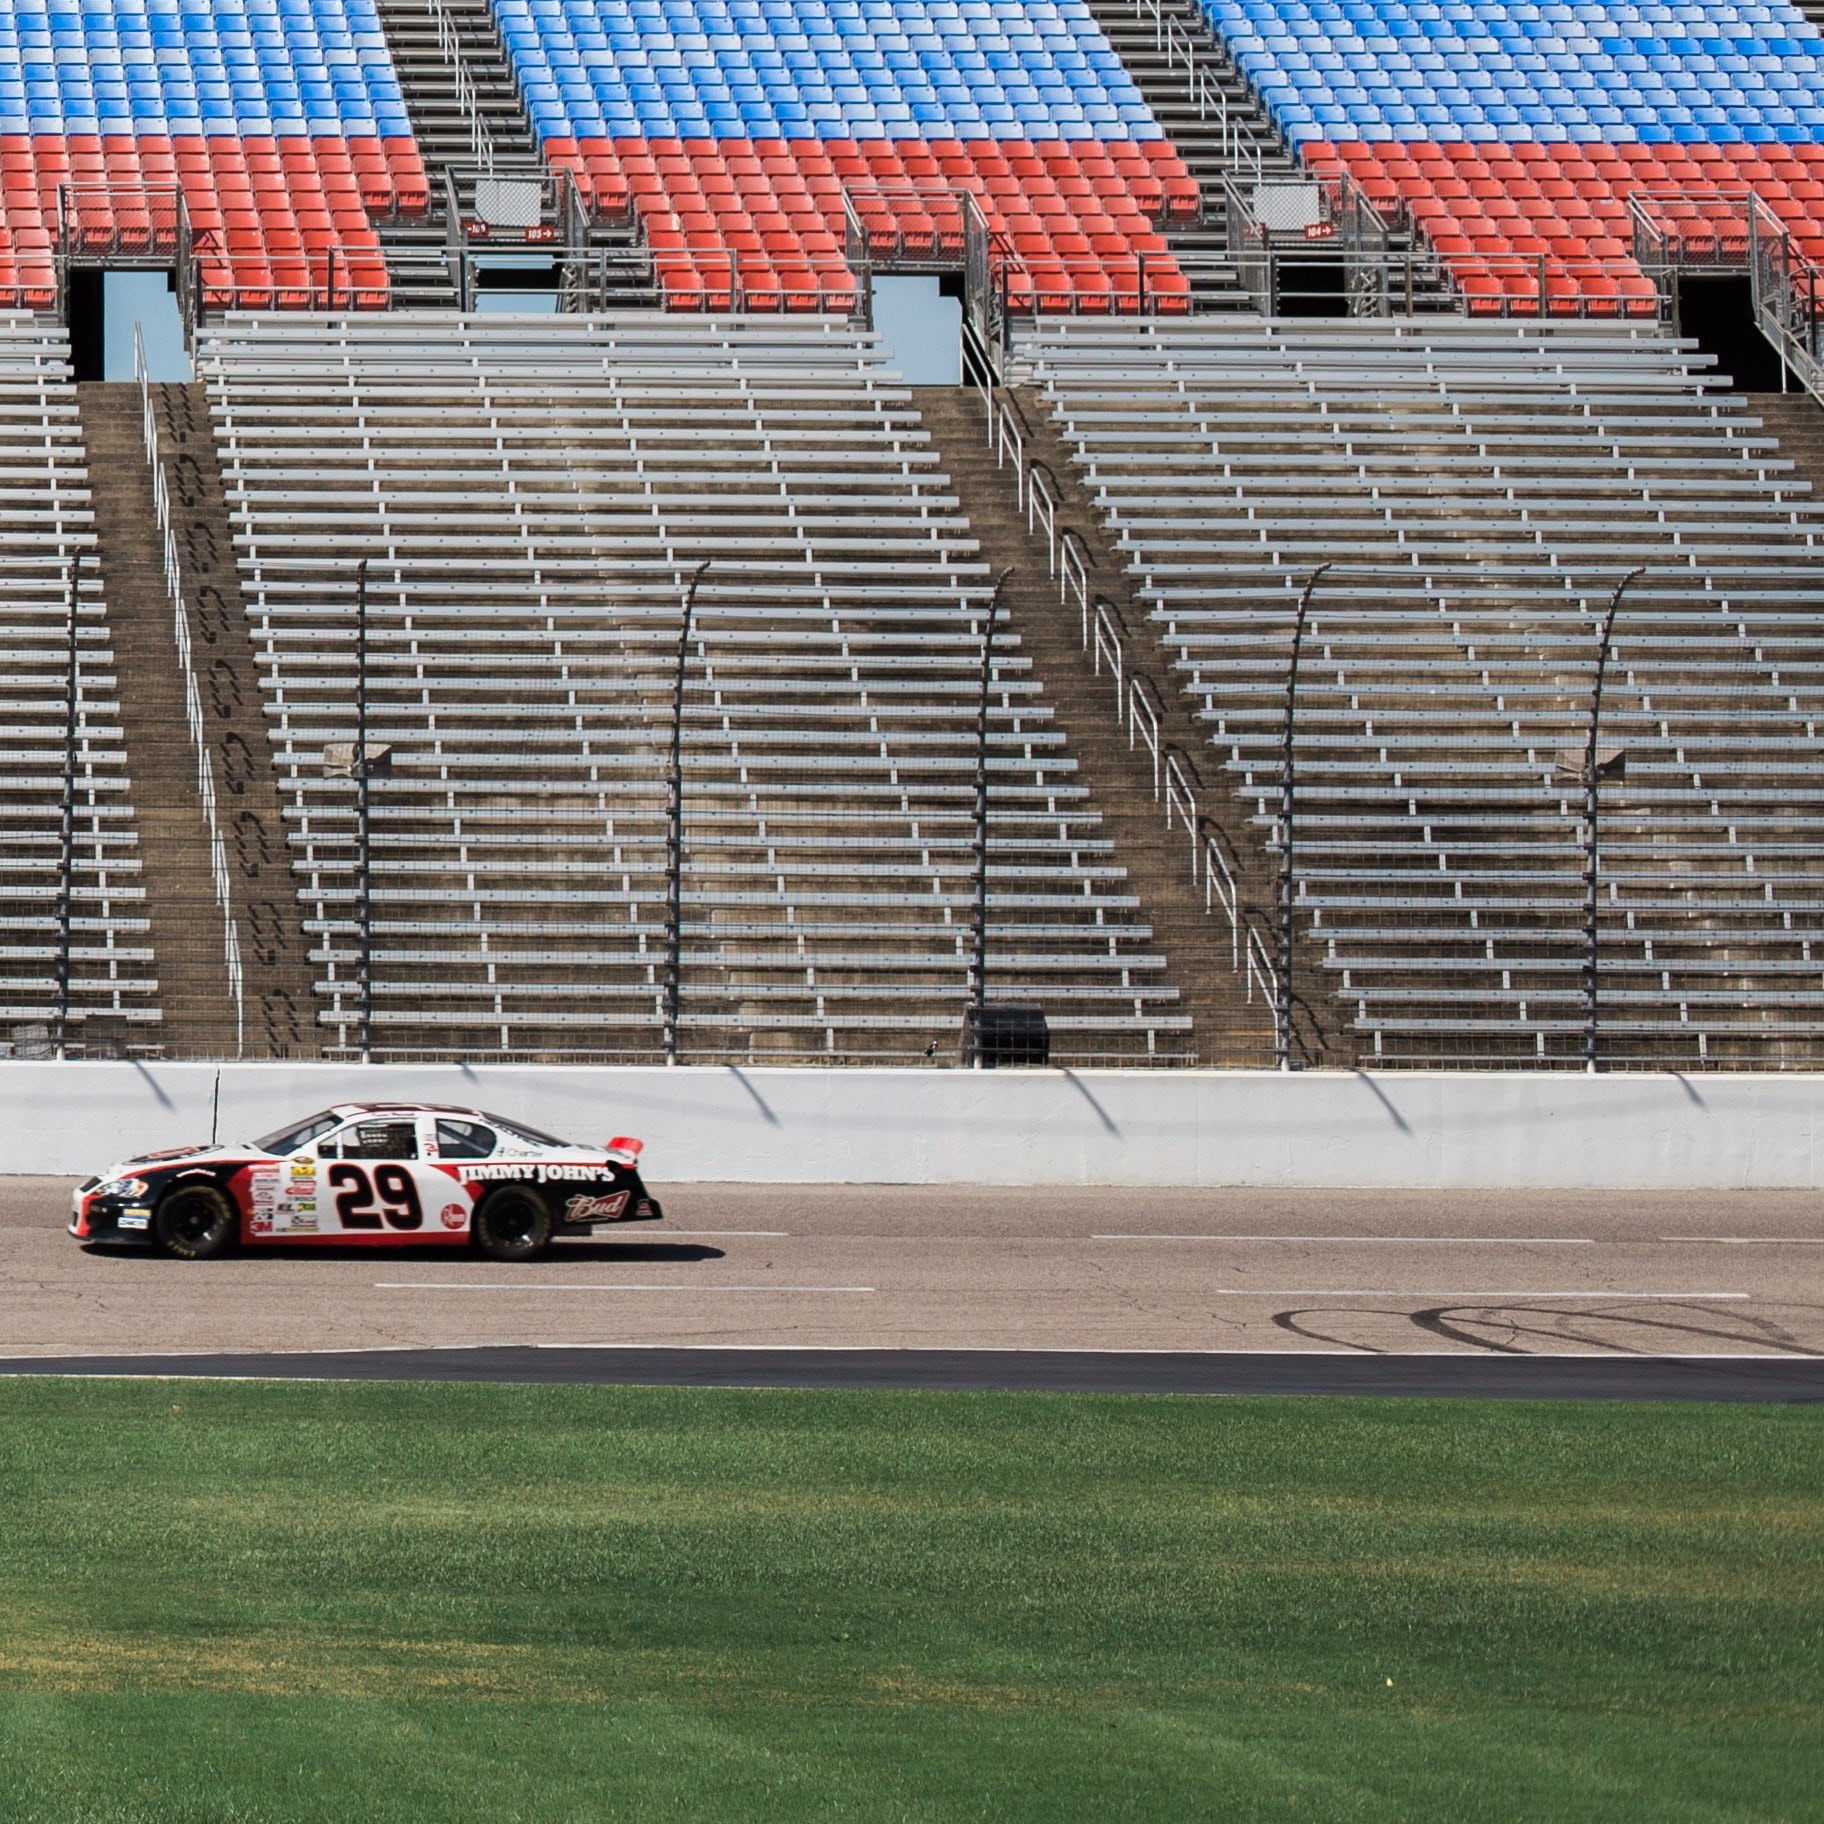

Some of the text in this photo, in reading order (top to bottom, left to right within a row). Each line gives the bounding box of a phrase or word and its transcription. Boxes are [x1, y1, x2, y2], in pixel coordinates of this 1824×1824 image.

[457, 1164, 616, 1185] JIMMY JOHN'S
[328, 1162, 423, 1231] 29
[565, 1193, 623, 1218] Bud
